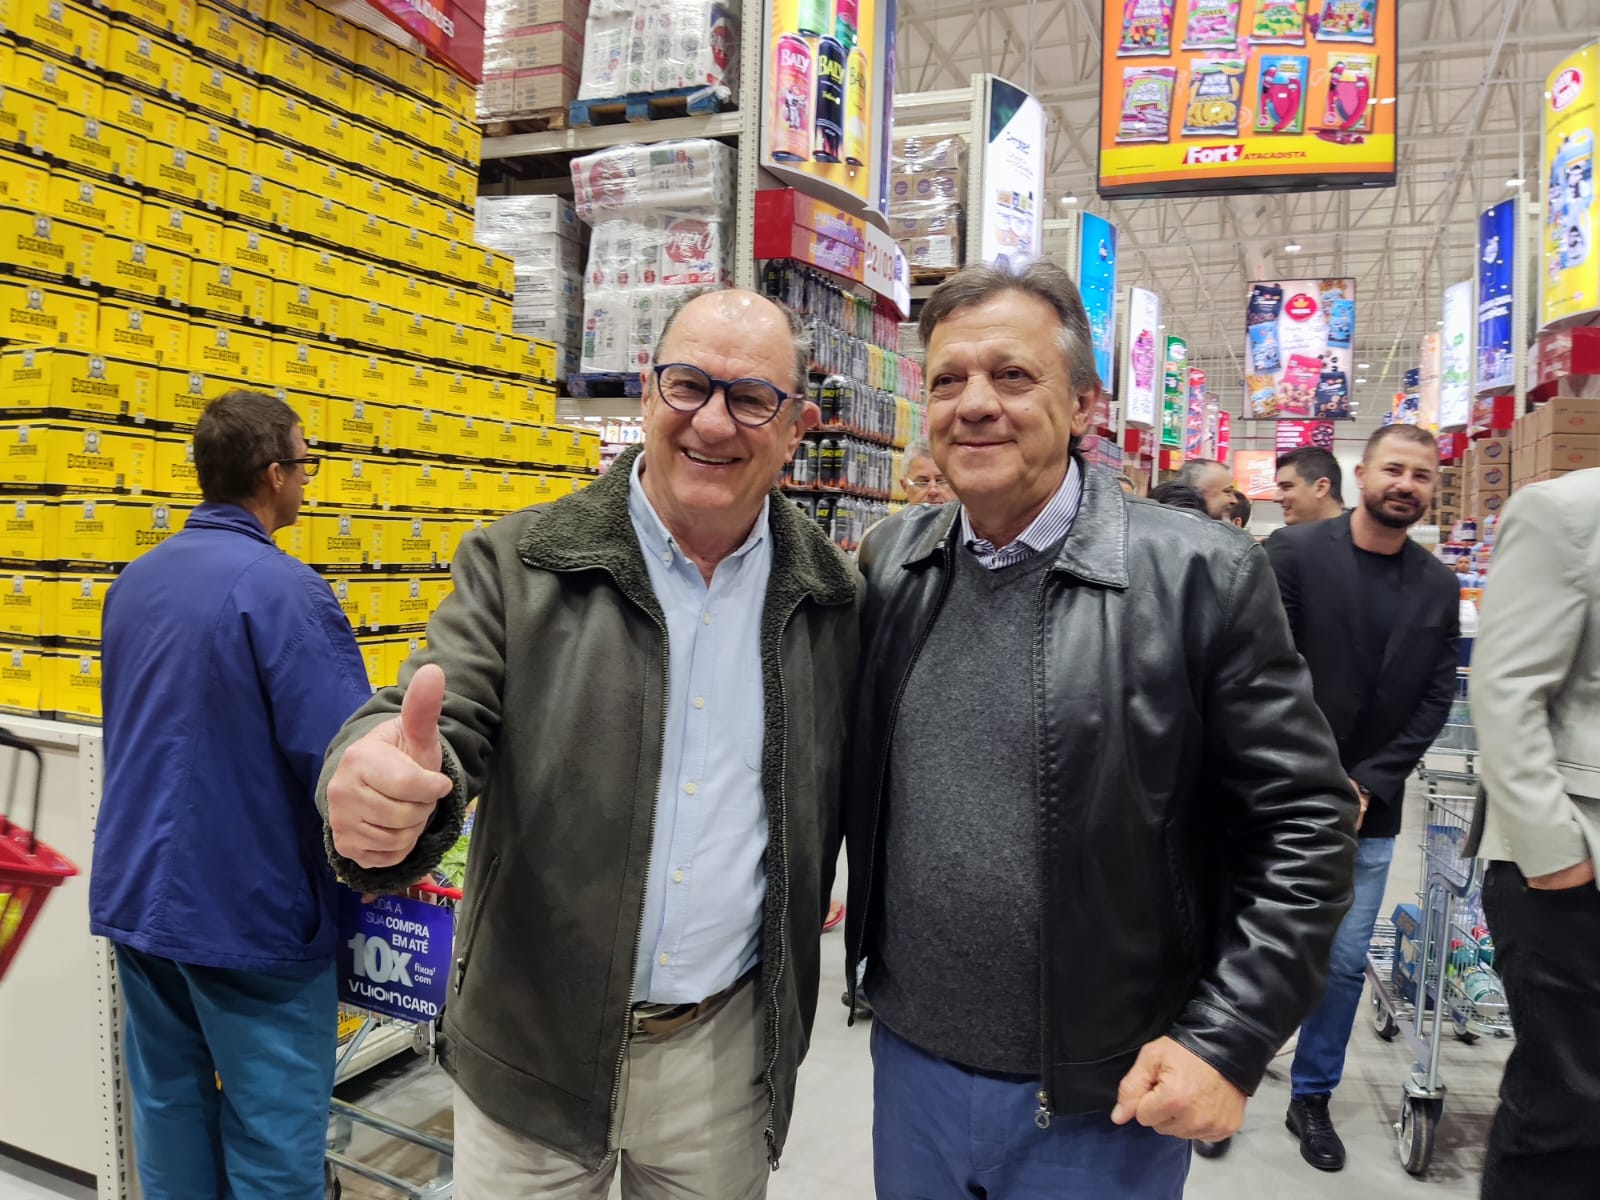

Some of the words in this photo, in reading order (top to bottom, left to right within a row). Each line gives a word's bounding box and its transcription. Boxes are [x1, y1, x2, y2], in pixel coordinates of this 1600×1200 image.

[1187, 146, 1240, 165] Fort
[1243, 151, 1307, 161] ATACADISTA
[394, 903, 402, 915] A
[366, 911, 386, 926] SUA
[385, 916, 430, 938] COMPRA
[392, 933, 409, 949] EM
[408, 939, 428, 954] ATÉ
[414, 974, 432, 985] com
